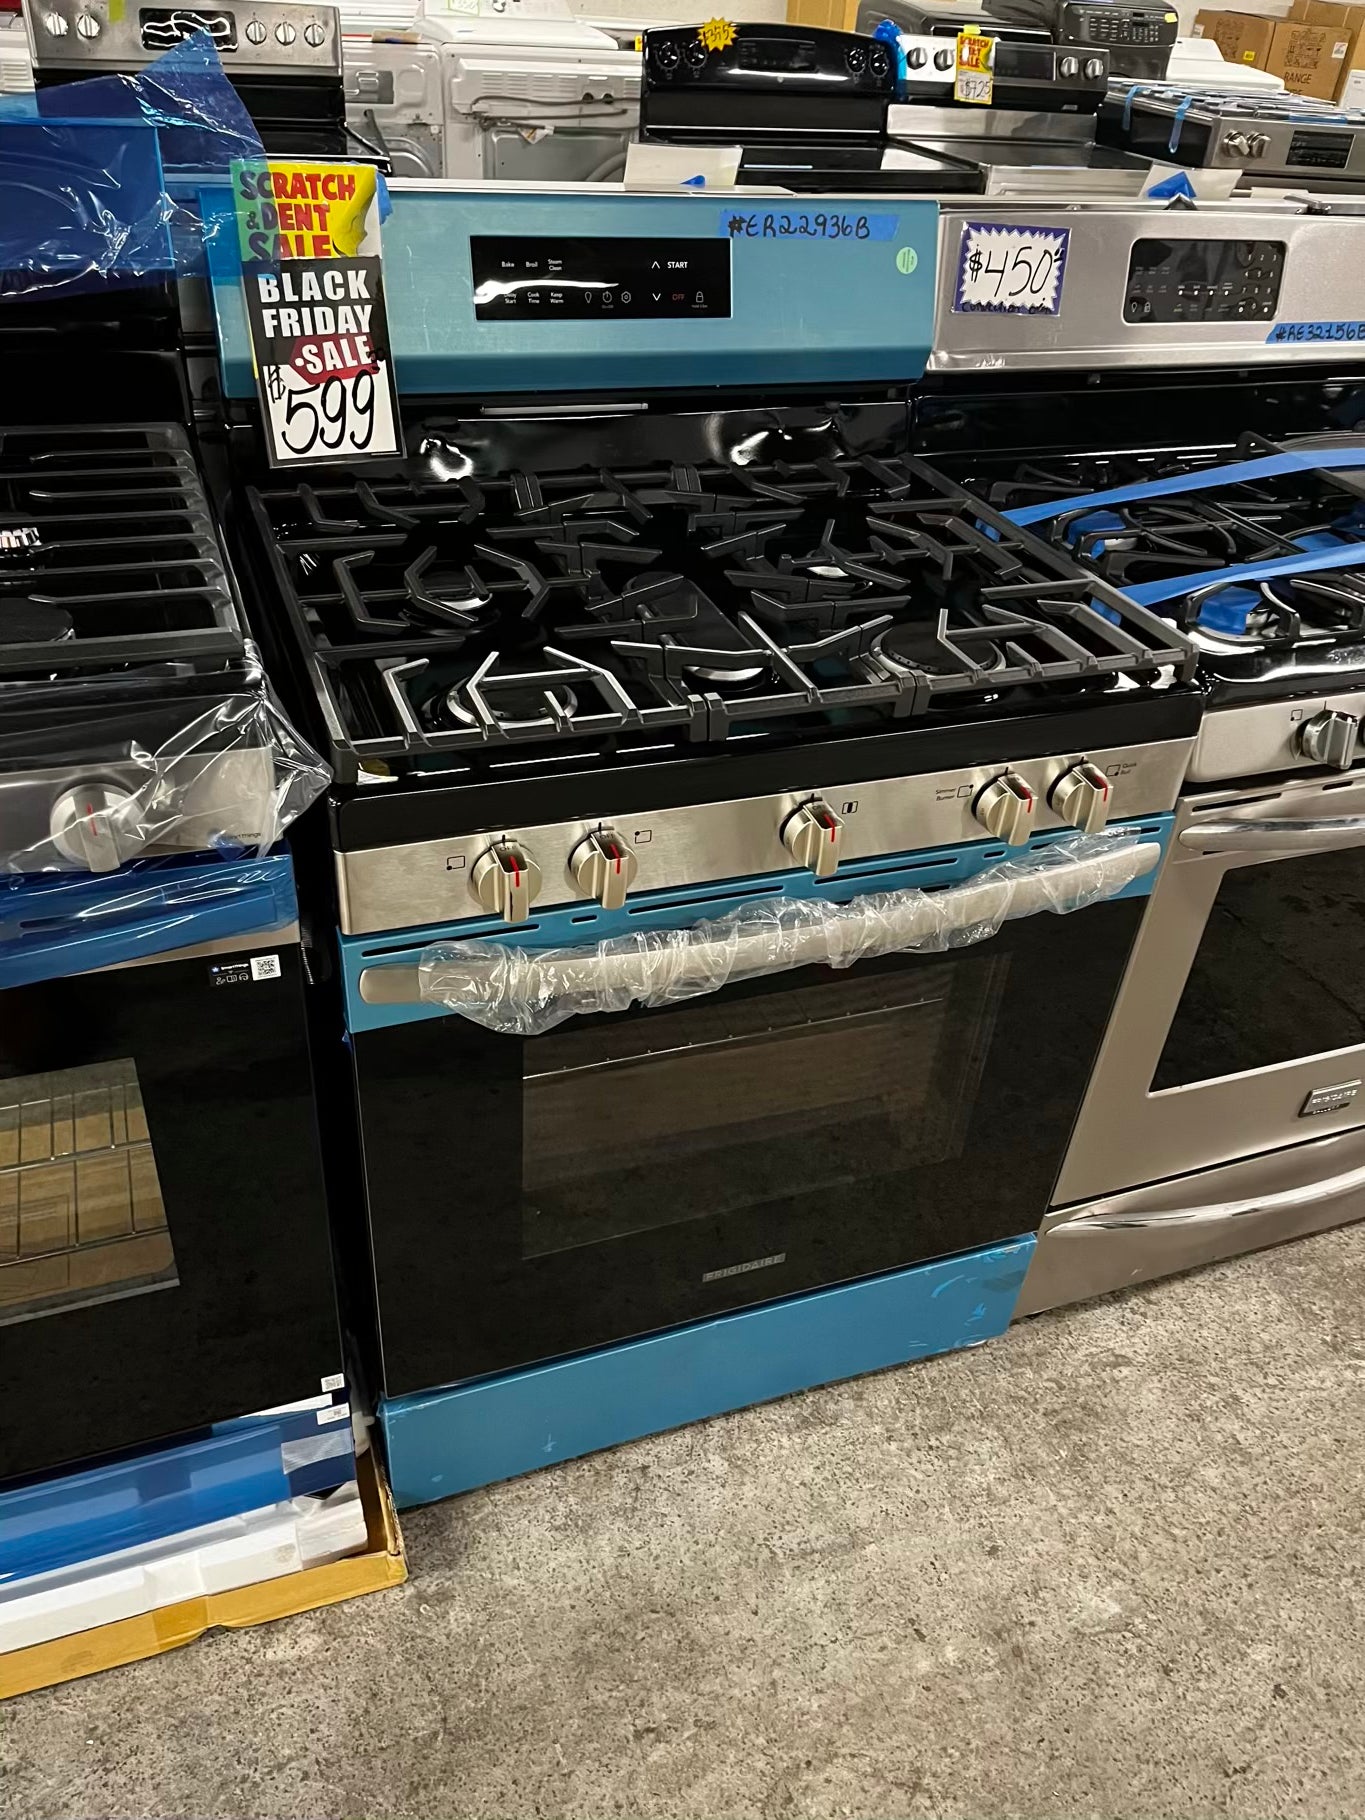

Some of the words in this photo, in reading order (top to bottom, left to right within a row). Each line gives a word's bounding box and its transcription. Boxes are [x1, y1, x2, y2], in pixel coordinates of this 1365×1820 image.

[1284, 71, 1312, 85] RANGE
[239, 170, 356, 201] SCRATCH
[245, 210, 260, 230] &
[260, 202, 331, 232] DENT
[728, 213, 871, 240] #ER22936B
[667, 261, 688, 269] START
[257, 270, 371, 303] BLACK
[672, 293, 685, 301] OFF
[262, 304, 373, 338] FRIDAY
[301, 335, 372, 374] SALE
[268, 365, 375, 455] $599
